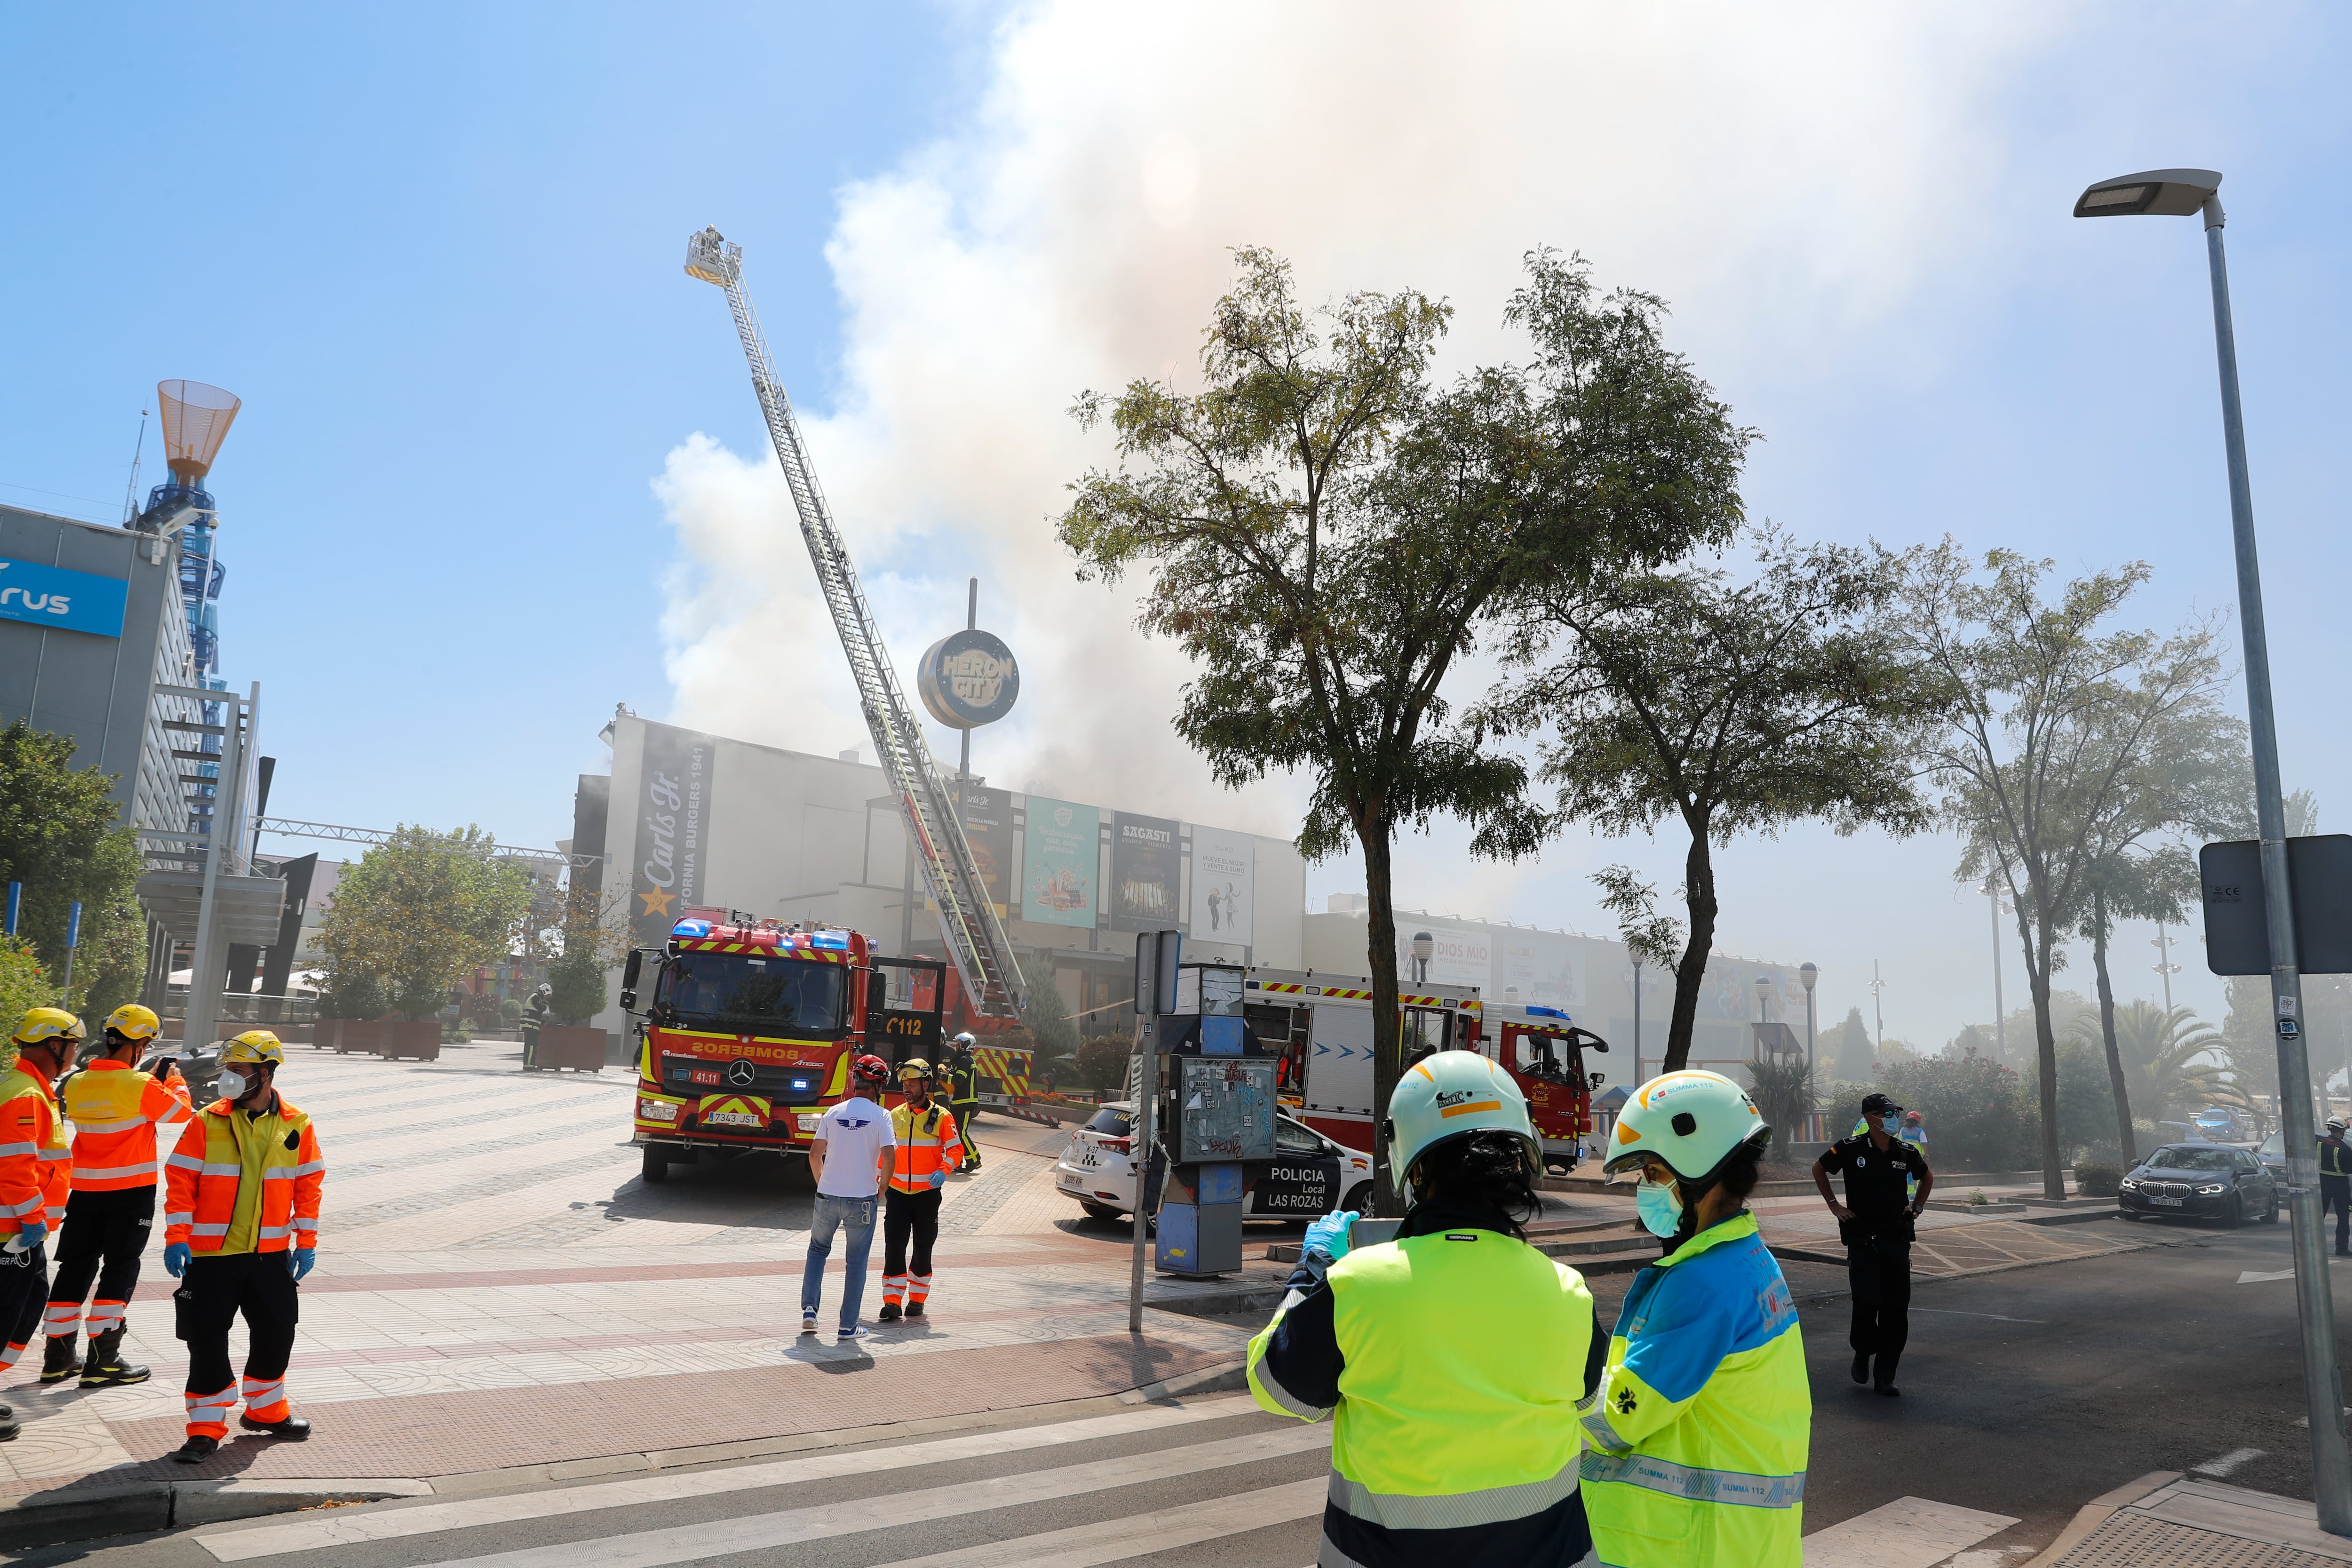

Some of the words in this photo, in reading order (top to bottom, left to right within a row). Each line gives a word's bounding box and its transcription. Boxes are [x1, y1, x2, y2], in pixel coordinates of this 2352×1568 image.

[943, 656, 1012, 680] HERON
[953, 677, 1001, 700] CITY
[691, 747, 704, 778] 1941
[650, 771, 681, 811] Jr.
[685, 781, 700, 848] BURGERS
[644, 812, 676, 888] Carl's
[680, 853, 695, 918] IFORNIA
[921, 869, 933, 898] MAGIRUS
[1438, 942, 1463, 957] DIOS
[1624, 972, 1641, 983] Urbn
[1642, 974, 1659, 985] Planet
[899, 1019, 922, 1035] 112
[696, 1072, 717, 1083] 41.11
[1247, 1076, 1254, 1086] 54
[1667, 1083, 1699, 1094] SUMMA
[1437, 1093, 1464, 1106] PACIFIC
[715, 1114, 736, 1122] 7343
[740, 1115, 756, 1123] JST
[1087, 1146, 1099, 1154] K-37
[1067, 1174, 1075, 1184] 2205
[1271, 1167, 1325, 1182] POLICIA
[1303, 1184, 1325, 1194] Local
[1269, 1194, 1287, 1207] LAS
[1290, 1195, 1324, 1209] ROZAS
[1638, 1467, 1669, 1481] SUMMA
[1671, 1476, 1684, 1485] 112
[1722, 1483, 1749, 1493] SUMMA
[1751, 1487, 1765, 1495] 112
